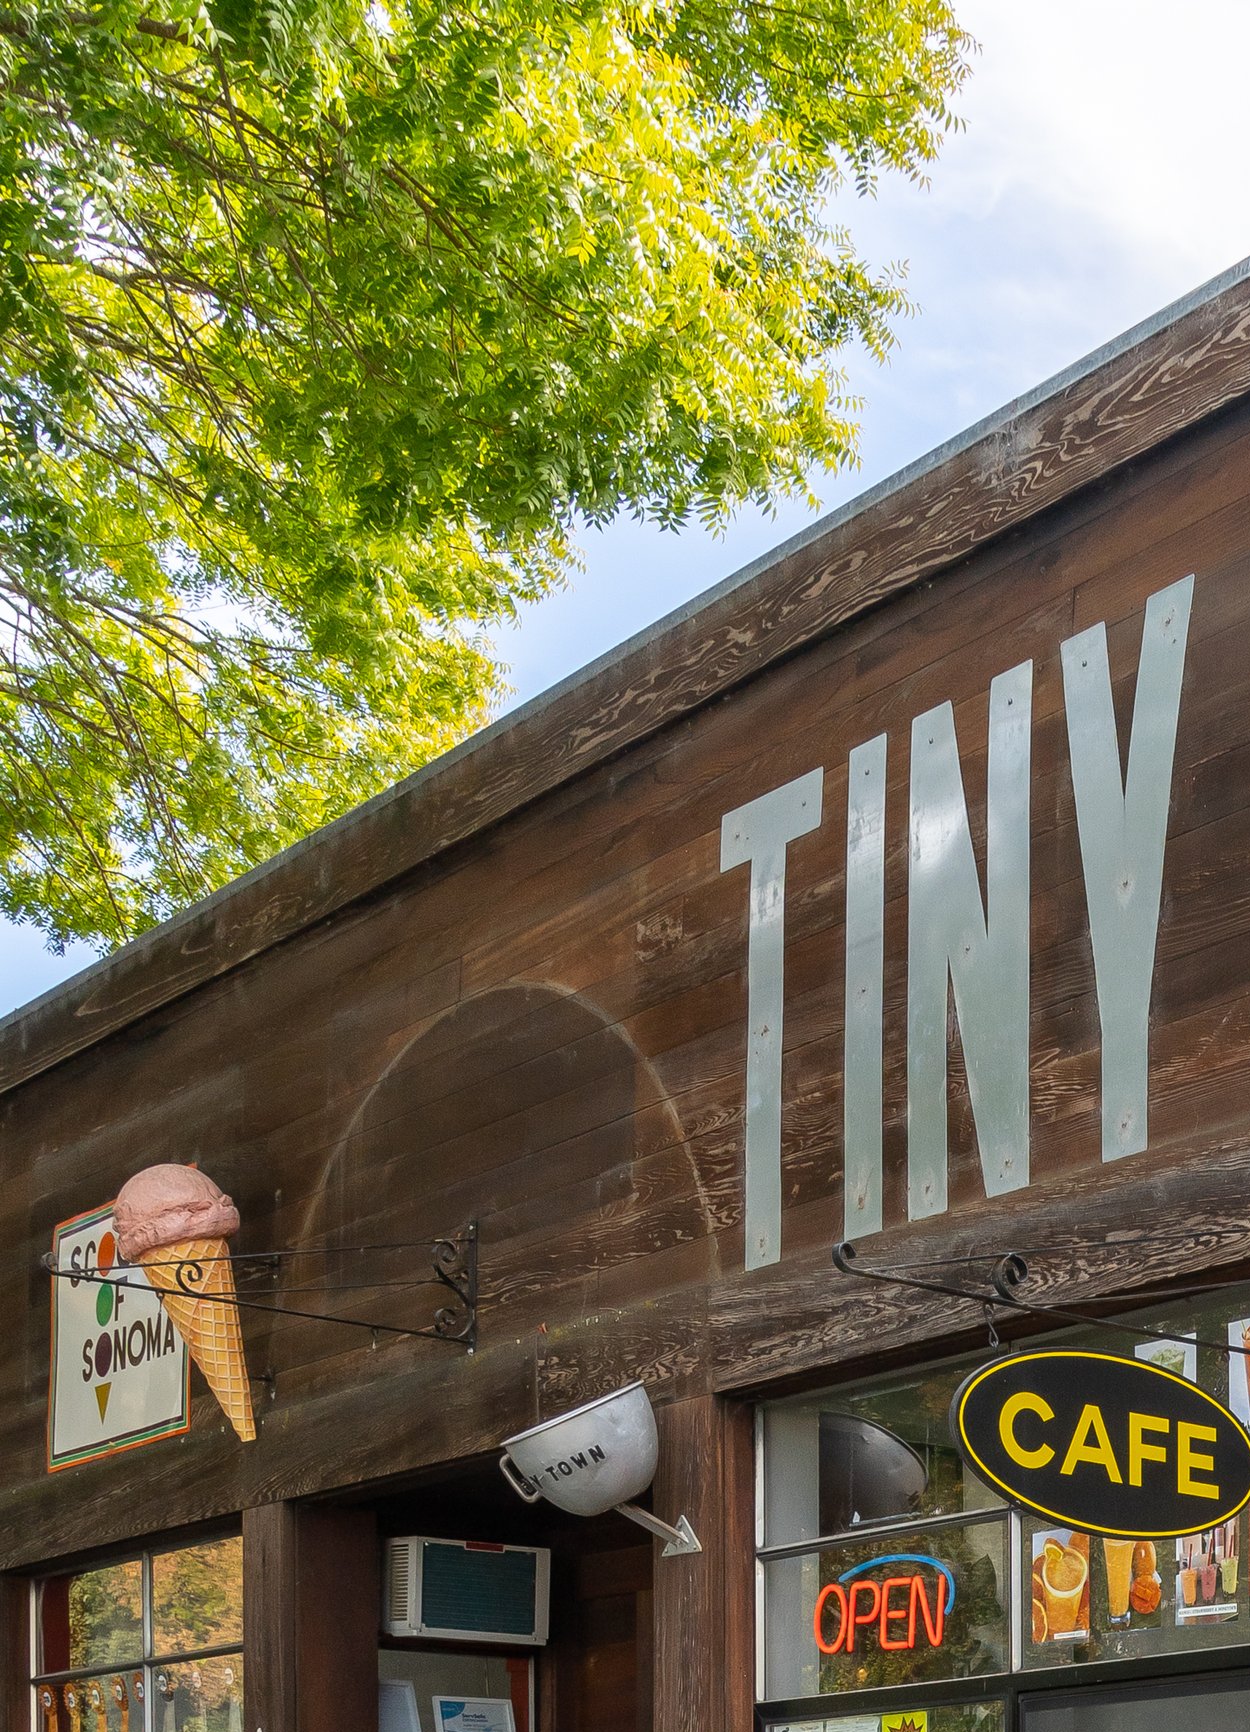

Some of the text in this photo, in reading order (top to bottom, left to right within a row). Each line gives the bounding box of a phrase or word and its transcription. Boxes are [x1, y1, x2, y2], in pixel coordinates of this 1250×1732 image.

[720, 573, 1195, 1271] TINY
[82, 1316, 176, 1382] SONOMA
[545, 1444, 606, 1482] TOWN
[998, 1391, 1220, 1500] CAFE
[813, 1573, 947, 1655] OPEN
